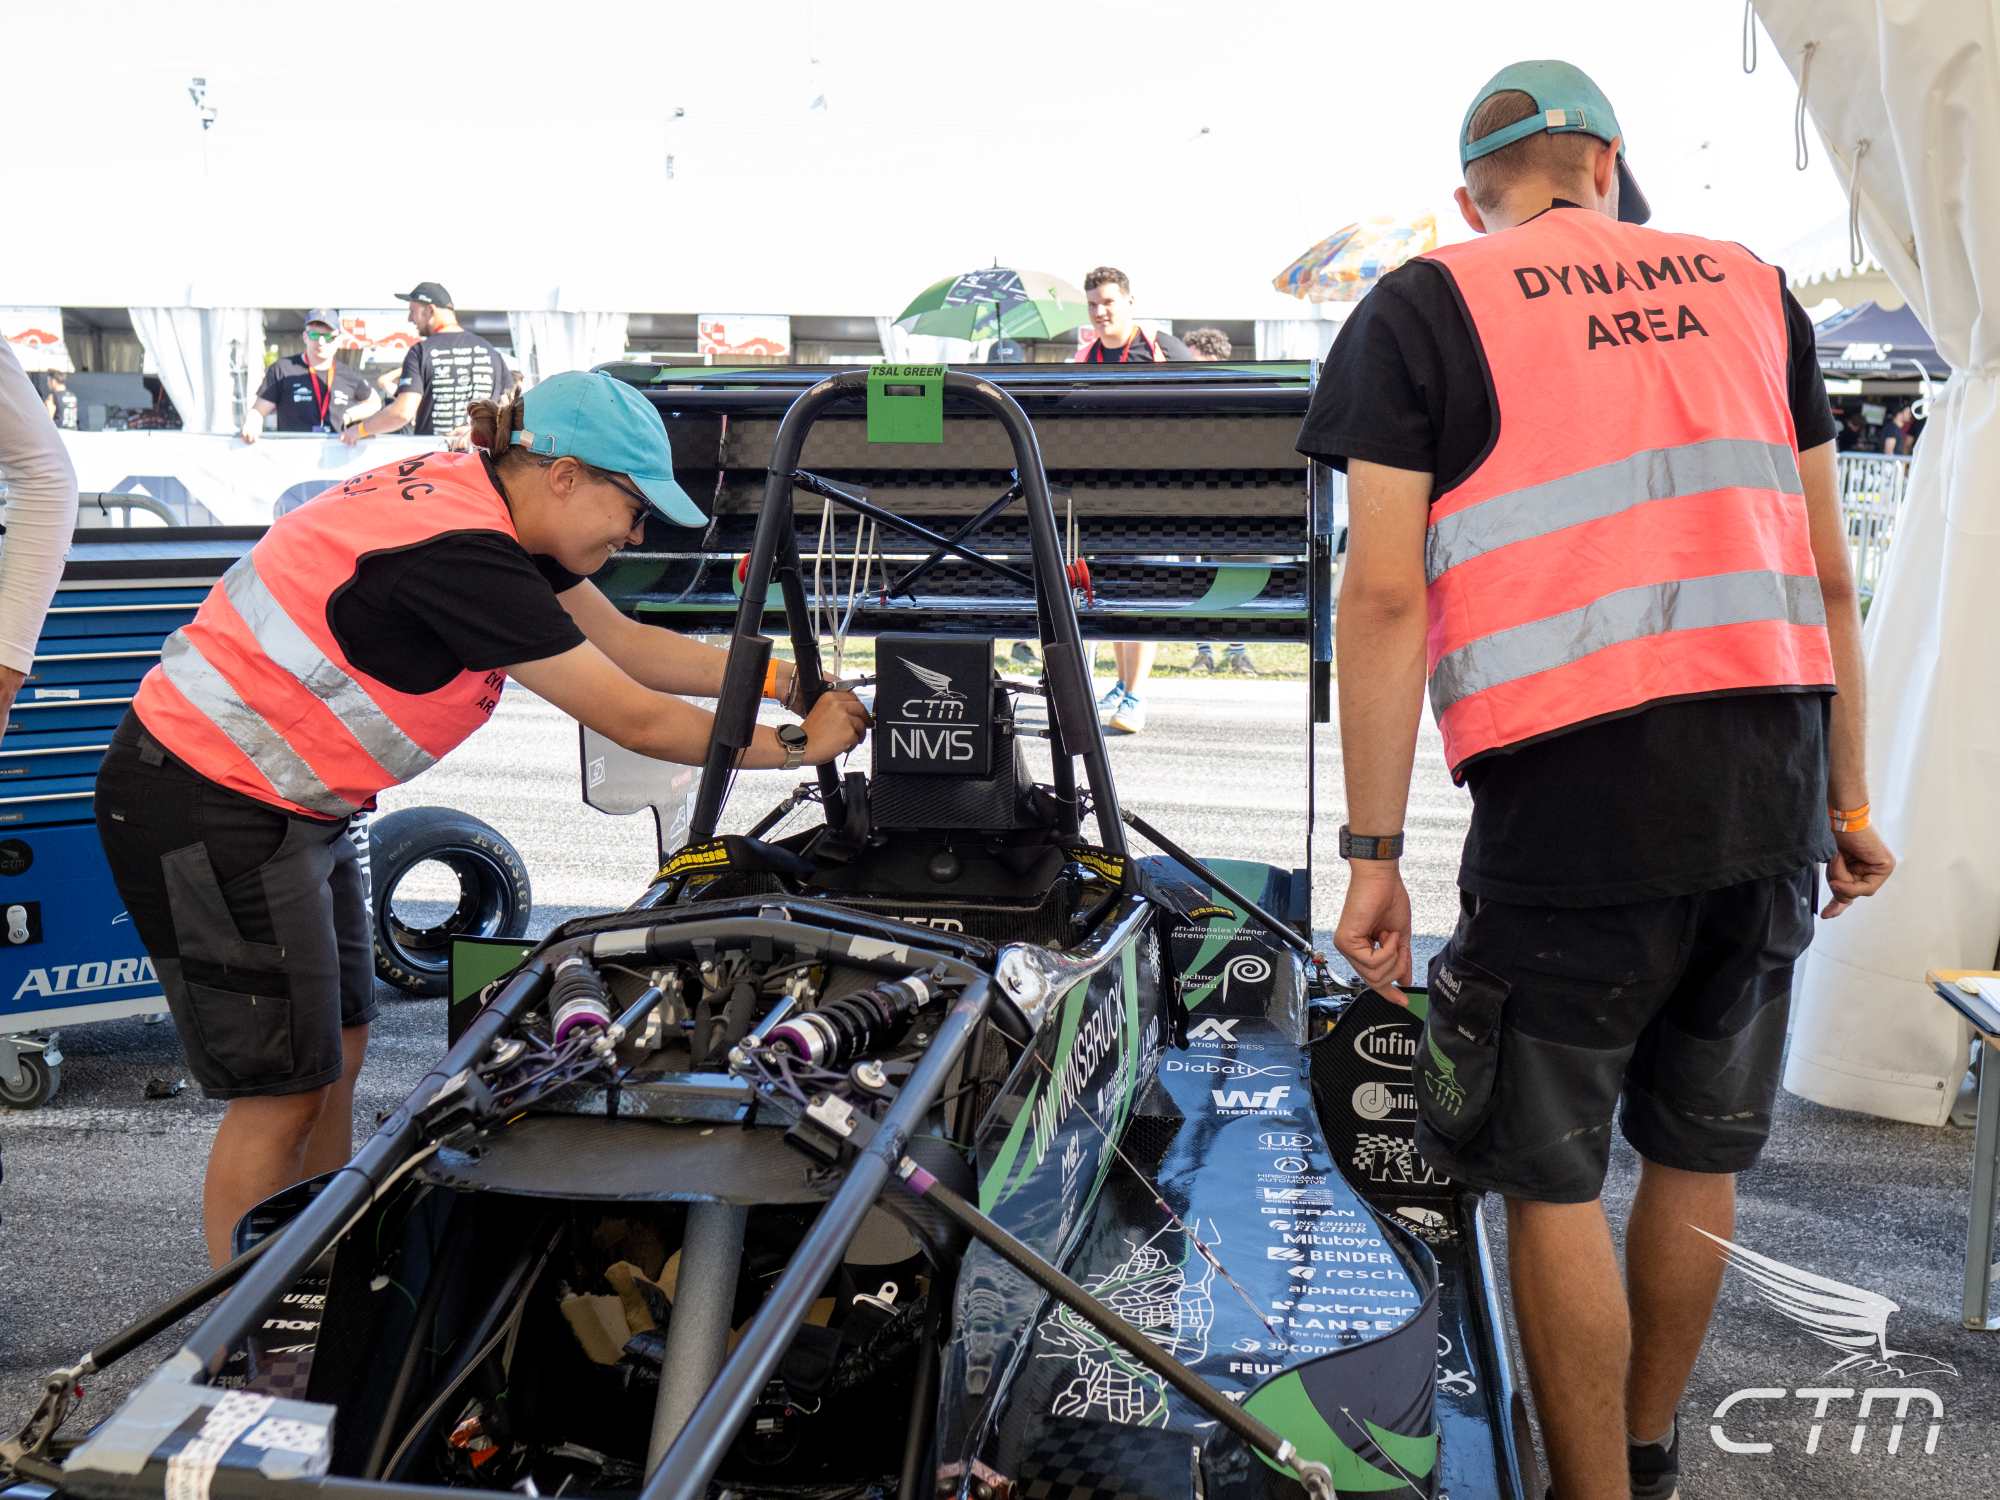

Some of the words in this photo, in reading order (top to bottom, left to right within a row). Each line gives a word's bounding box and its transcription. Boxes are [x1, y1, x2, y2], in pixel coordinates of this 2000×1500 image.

[1513, 253, 1726, 300] DYNAMIC
[1588, 304, 1710, 351] AREA
[871, 366, 900, 376] TSAL
[903, 367, 943, 377] GREEN
[475, 695, 497, 716] AR
[902, 699, 964, 720] CTM
[891, 728, 974, 761] NIVIS
[1233, 927, 1267, 936] Wiener
[1181, 981, 1217, 989] Florian
[1438, 962, 1462, 995] Waibel
[1032, 1080, 1058, 1166] UNI
[1056, 975, 1127, 1125] INNSBRUCK
[1425, 1070, 1462, 1116] CTM
[1216, 1109, 1292, 1117] mechanik
[1369, 1149, 1451, 1186] KW
[1257, 1173, 1327, 1181] HIRSCHMANN
[1257, 1177, 1327, 1185] AUTOMOTIVE
[1260, 1207, 1355, 1218] GEFRAN
[1294, 1225, 1367, 1234] FISCHER
[1282, 1233, 1381, 1249] Mitutoyo
[1310, 1250, 1394, 1265] BENDER
[1326, 1269, 1404, 1281] resch
[280, 1293, 326, 1305] UER
[262, 1319, 320, 1332] nor
[1266, 1315, 1404, 1332] PLANSE
[1290, 1330, 1309, 1338] The
[1312, 1332, 1357, 1340] Plansee
[1229, 1362, 1288, 1375] FEUE
